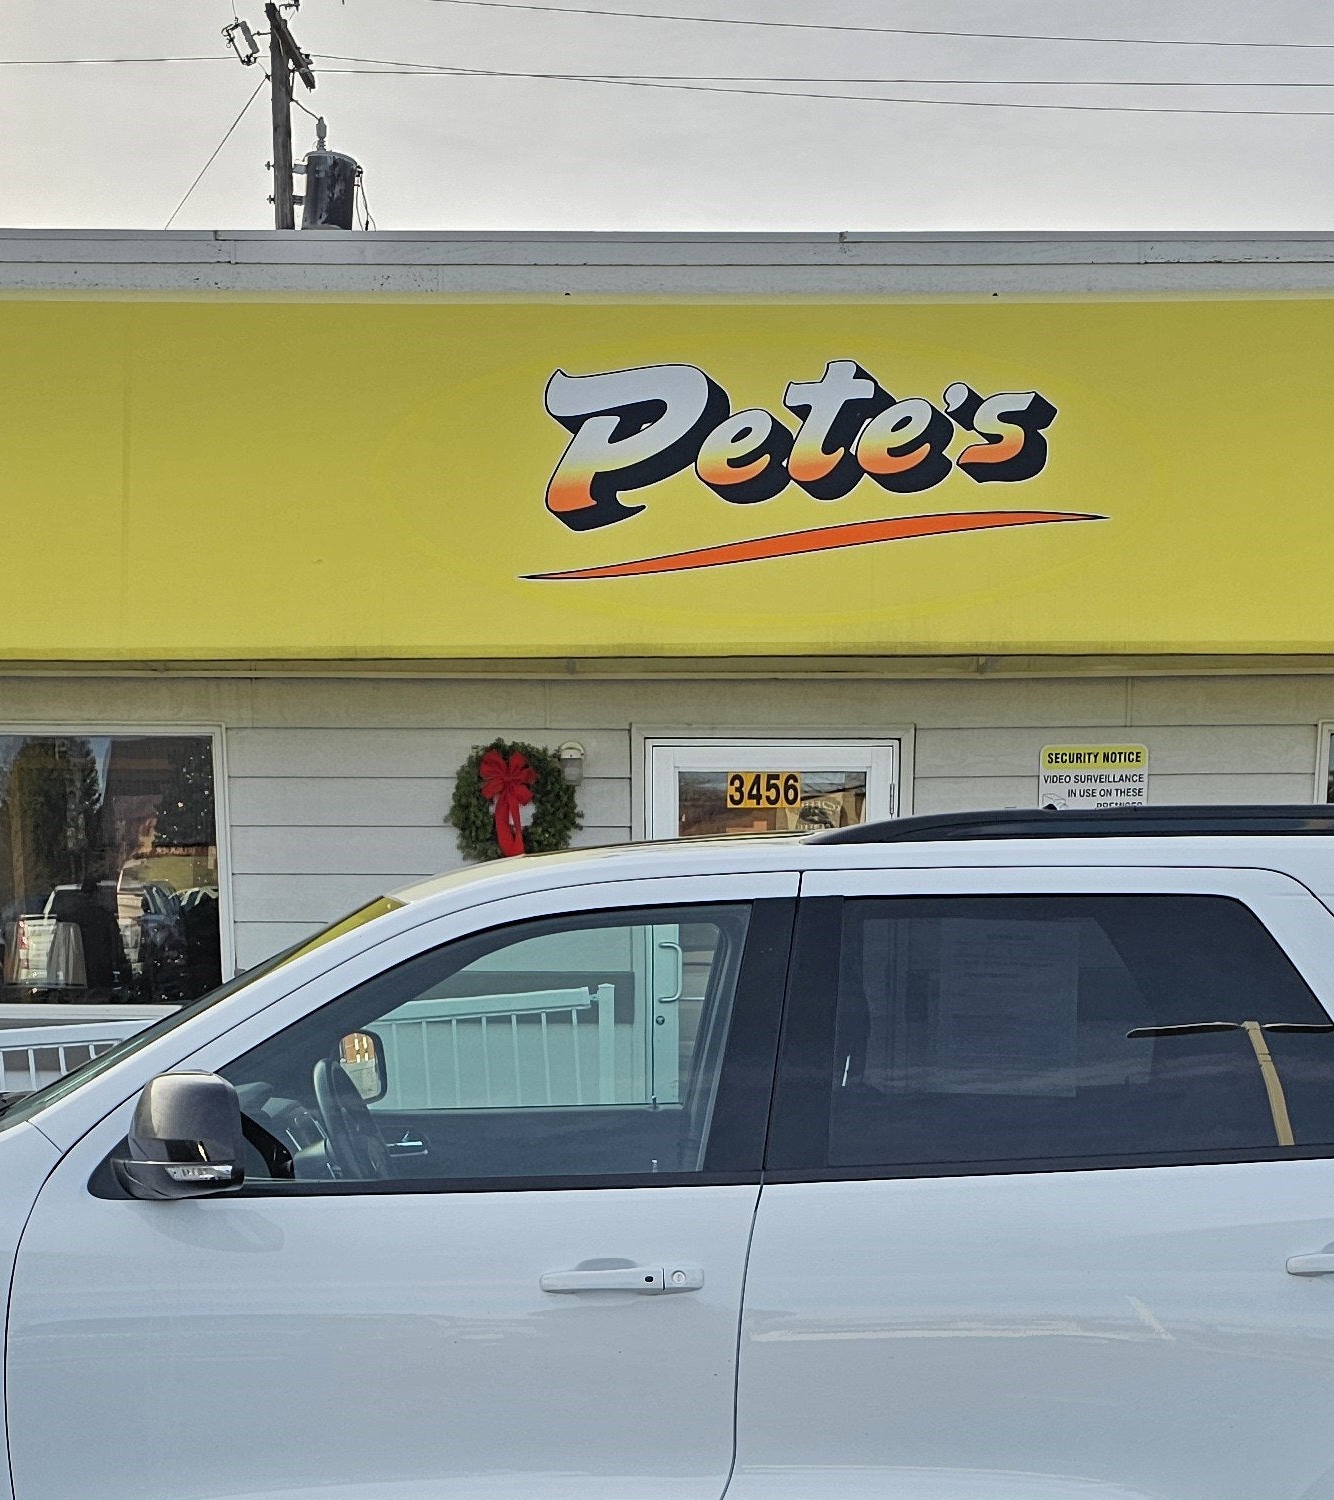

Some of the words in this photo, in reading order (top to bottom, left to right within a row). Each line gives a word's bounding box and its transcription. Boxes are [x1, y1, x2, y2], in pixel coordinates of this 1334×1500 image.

[544, 359, 1057, 530] Pete's
[1047, 752, 1099, 764] SECURITY
[1102, 751, 1142, 763] NOTICE
[1043, 775, 1071, 784] VIDEO
[1073, 774, 1144, 783] SURVEILLANCE
[728, 773, 800, 806] 3456
[1067, 789, 1077, 798] IN
[1079, 788, 1097, 798] USE
[1099, 788, 1112, 797] ON
[1114, 787, 1144, 797] THESE
